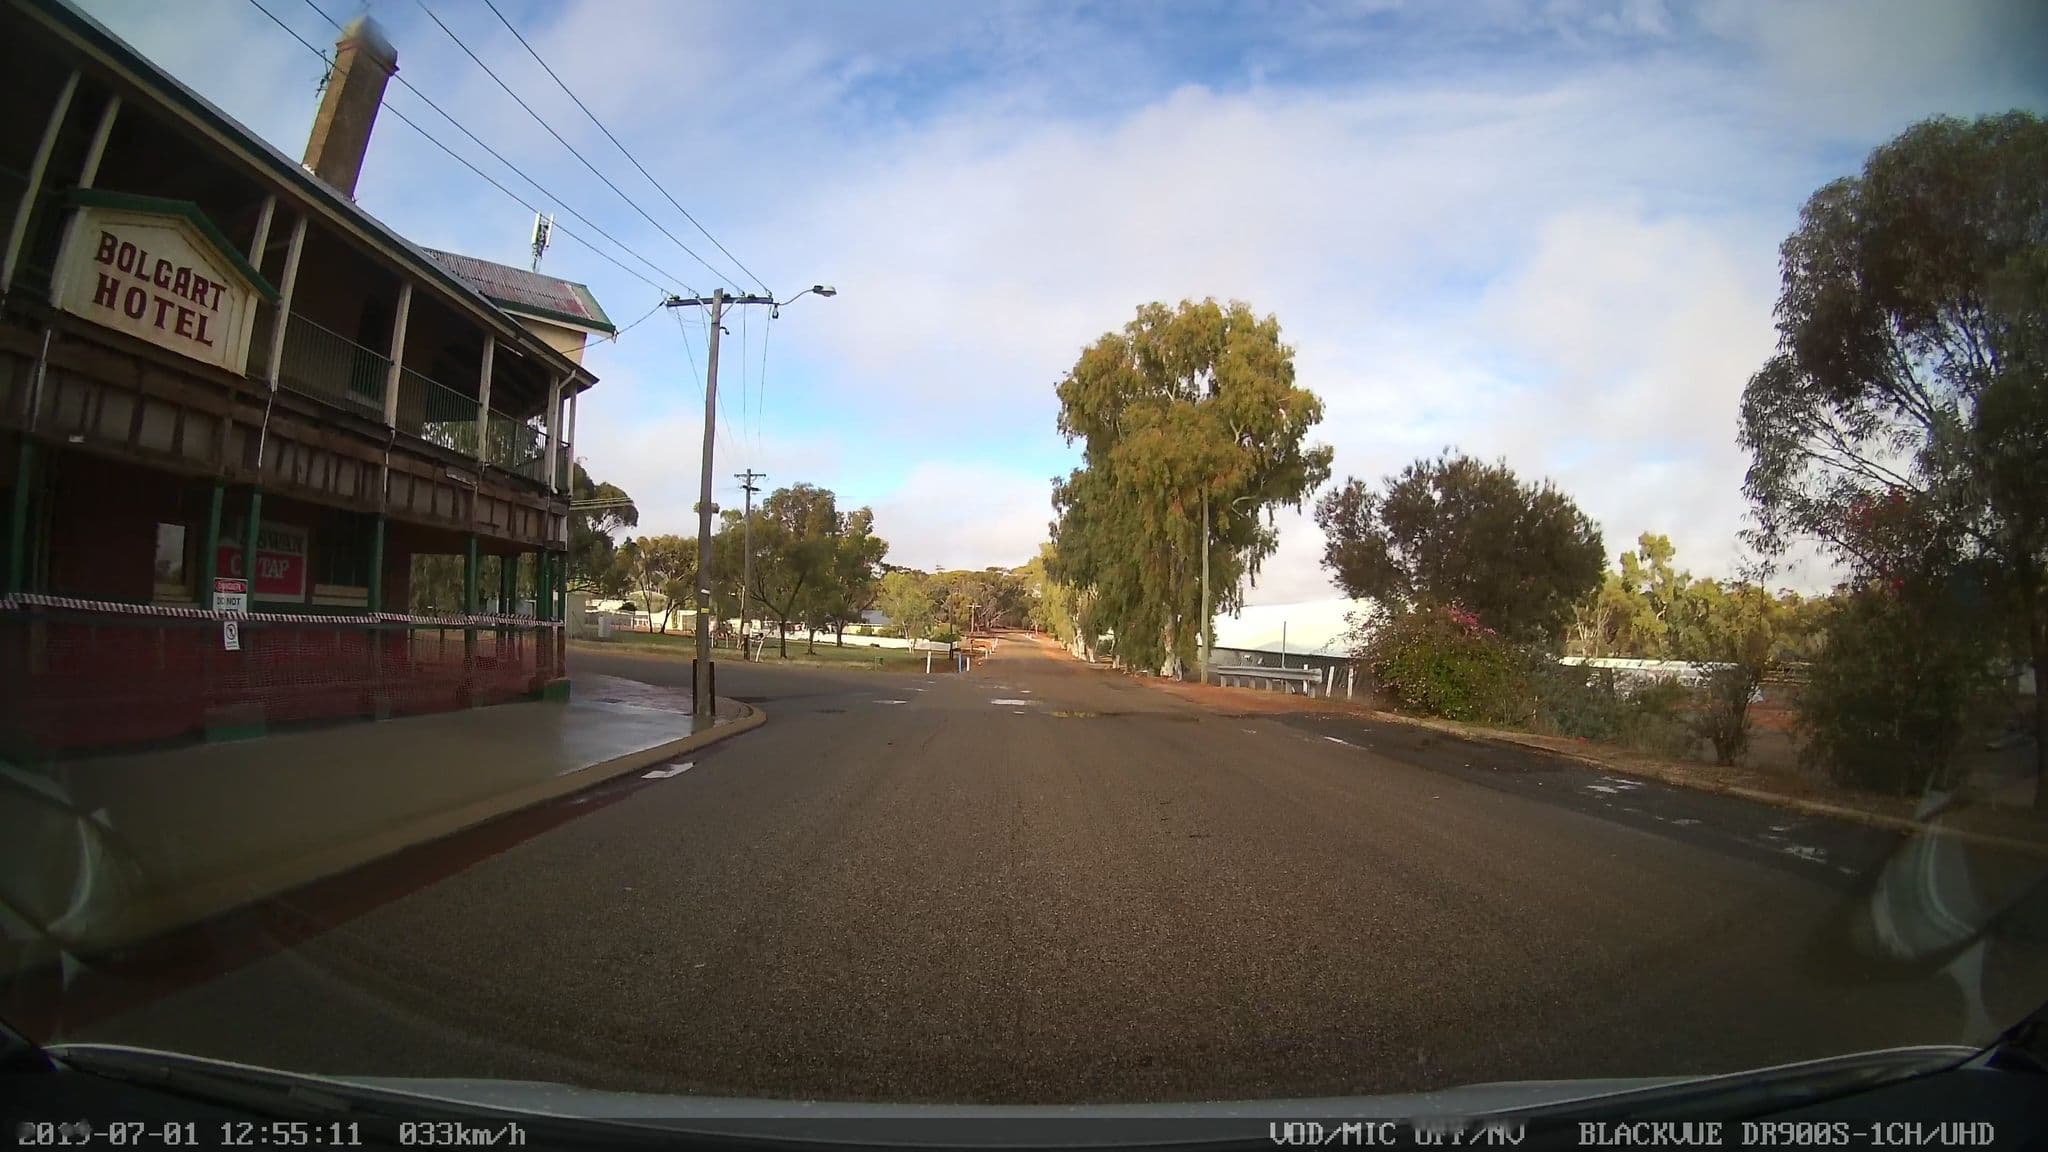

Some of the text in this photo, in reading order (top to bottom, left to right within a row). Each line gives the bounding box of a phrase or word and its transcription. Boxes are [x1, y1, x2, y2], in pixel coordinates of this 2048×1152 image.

[94, 230, 227, 312] BOLGART
[92, 272, 213, 347] HOTEL
[227, 597, 241, 606] NOT
